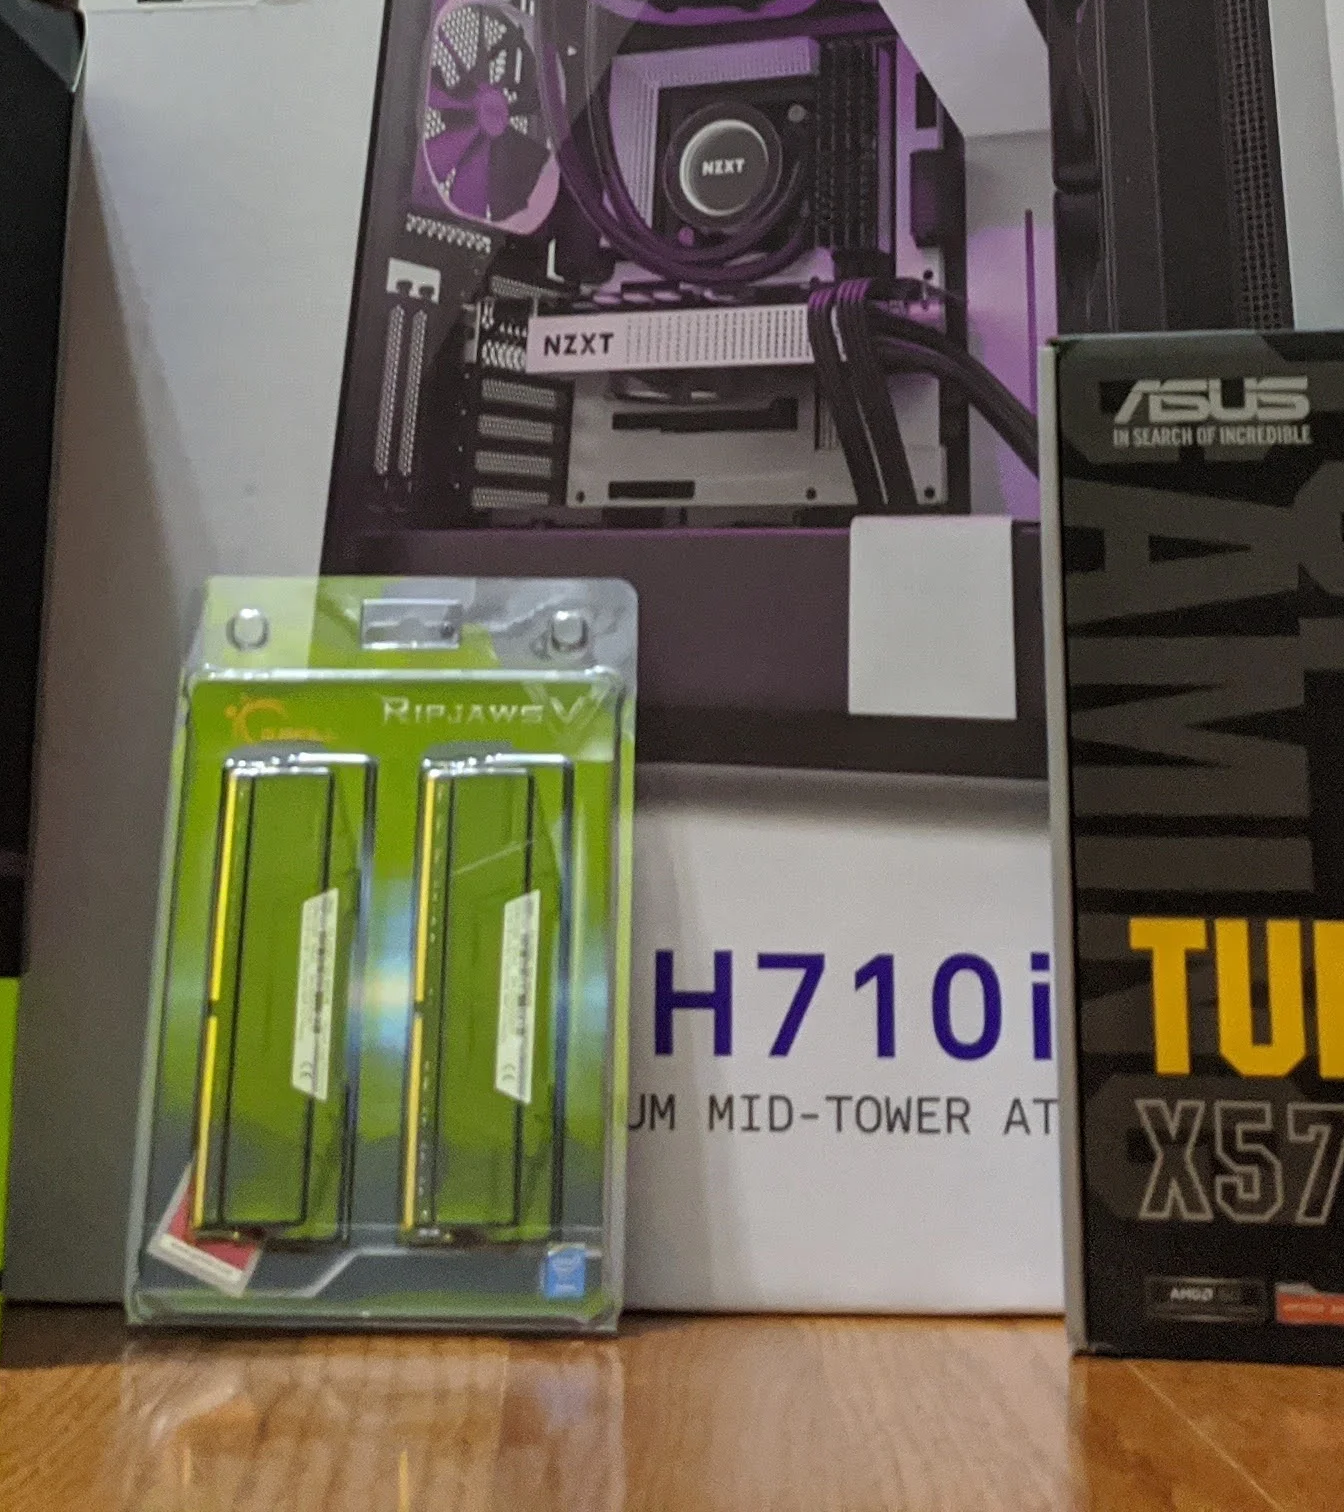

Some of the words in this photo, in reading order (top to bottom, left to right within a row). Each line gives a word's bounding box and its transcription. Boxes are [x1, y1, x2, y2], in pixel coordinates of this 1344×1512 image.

[701, 157, 746, 178] NZXT
[543, 333, 615, 356] NZXT
[1113, 376, 1311, 425] ASUS
[1113, 426, 1130, 447] IN
[1133, 425, 1193, 447] SEARCH
[1197, 425, 1217, 446] OF
[1219, 423, 1312, 445] INCREDIBLE
[654, 948, 1053, 1061] H710i
[707, 1093, 972, 1135] MID-TOWER
